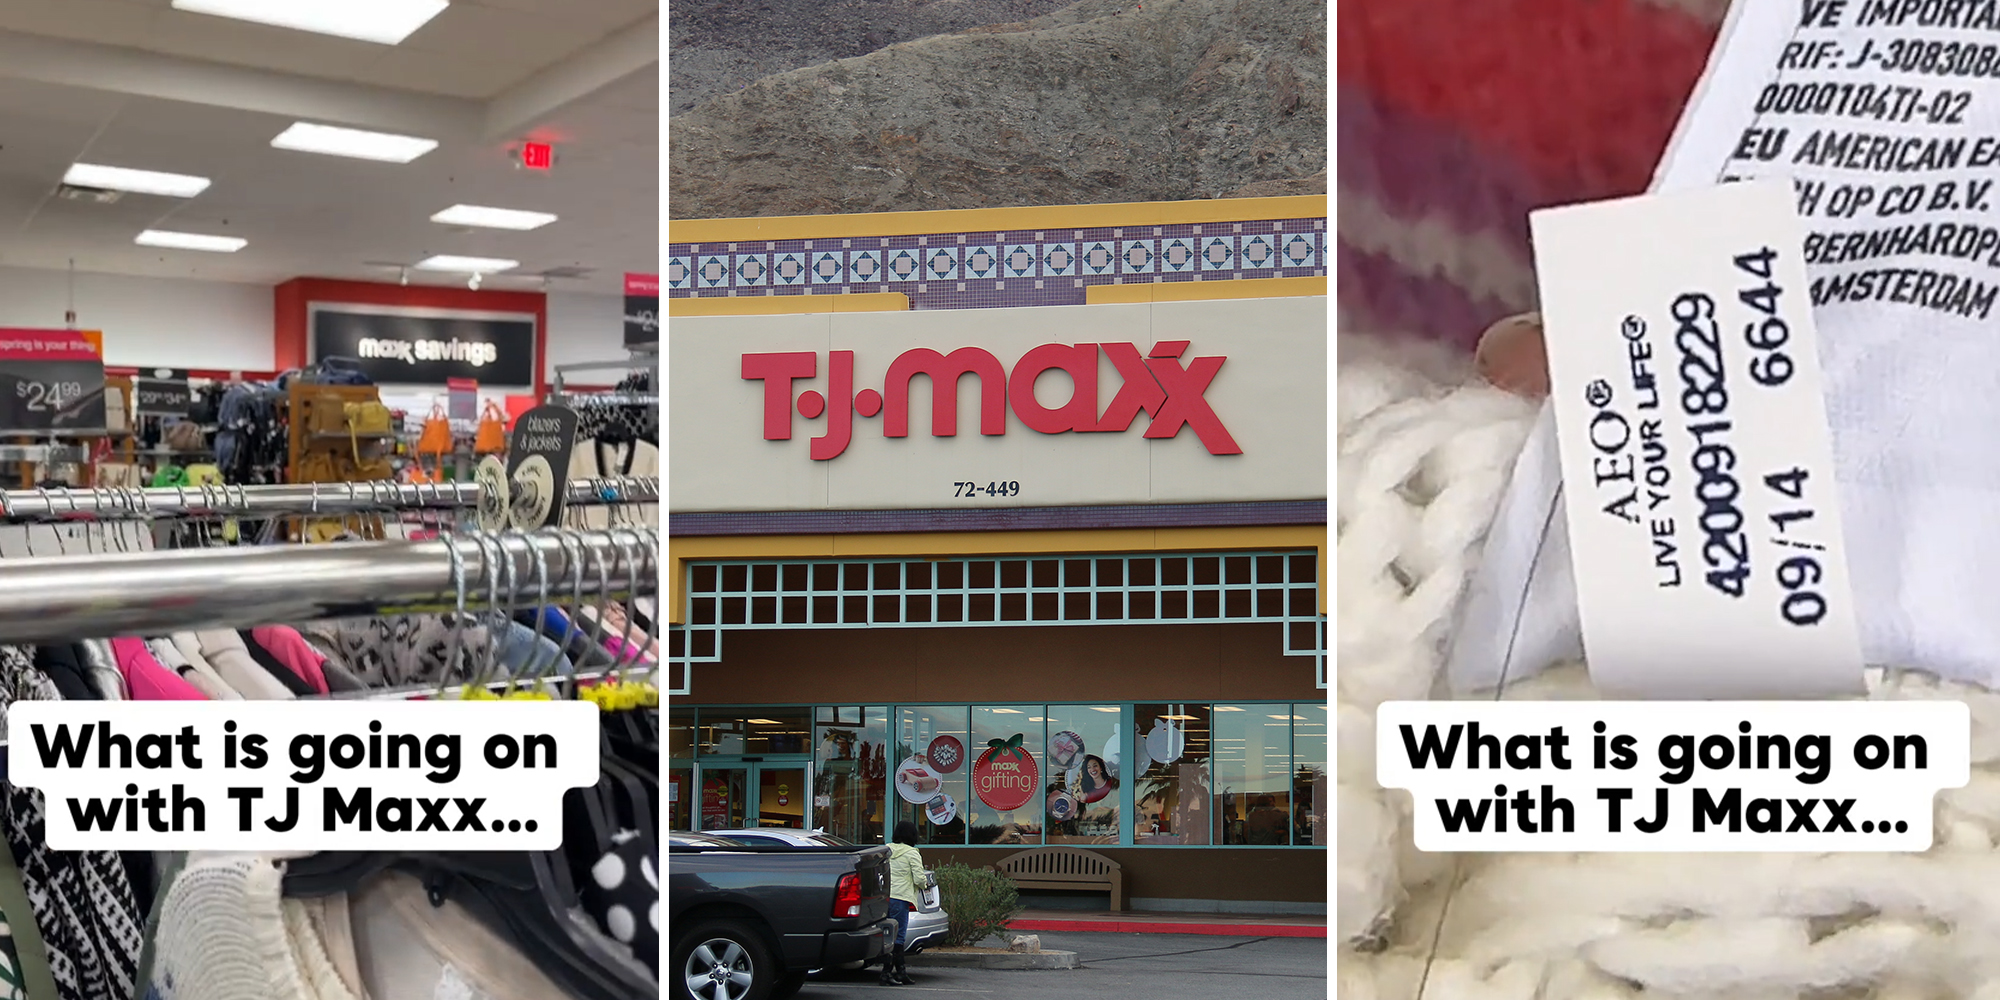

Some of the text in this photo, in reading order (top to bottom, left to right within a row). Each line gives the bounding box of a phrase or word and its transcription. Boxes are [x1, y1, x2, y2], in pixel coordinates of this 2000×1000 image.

[1778, 40, 1844, 70] RIF:
[1733, 127, 1789, 161] EU
[1792, 129, 1966, 173] AMERICAN
[1826, 183, 1875, 219] OP
[1876, 184, 1926, 217] CO
[1926, 179, 1992, 213] B.V.
[1733, 246, 1794, 387] 6644
[415, 337, 497, 367] savings
[527, 416, 562, 432] blazers
[527, 434, 562, 452] jackets
[1671, 292, 1751, 598] 4200918229
[1639, 419, 1670, 511] YOUR
[954, 481, 1020, 498] 72-449
[1651, 517, 1681, 588] LIVE
[1764, 466, 1827, 627] 09/14
[981, 772, 1031, 792] gifting
[991, 762, 1021, 773] maxx
